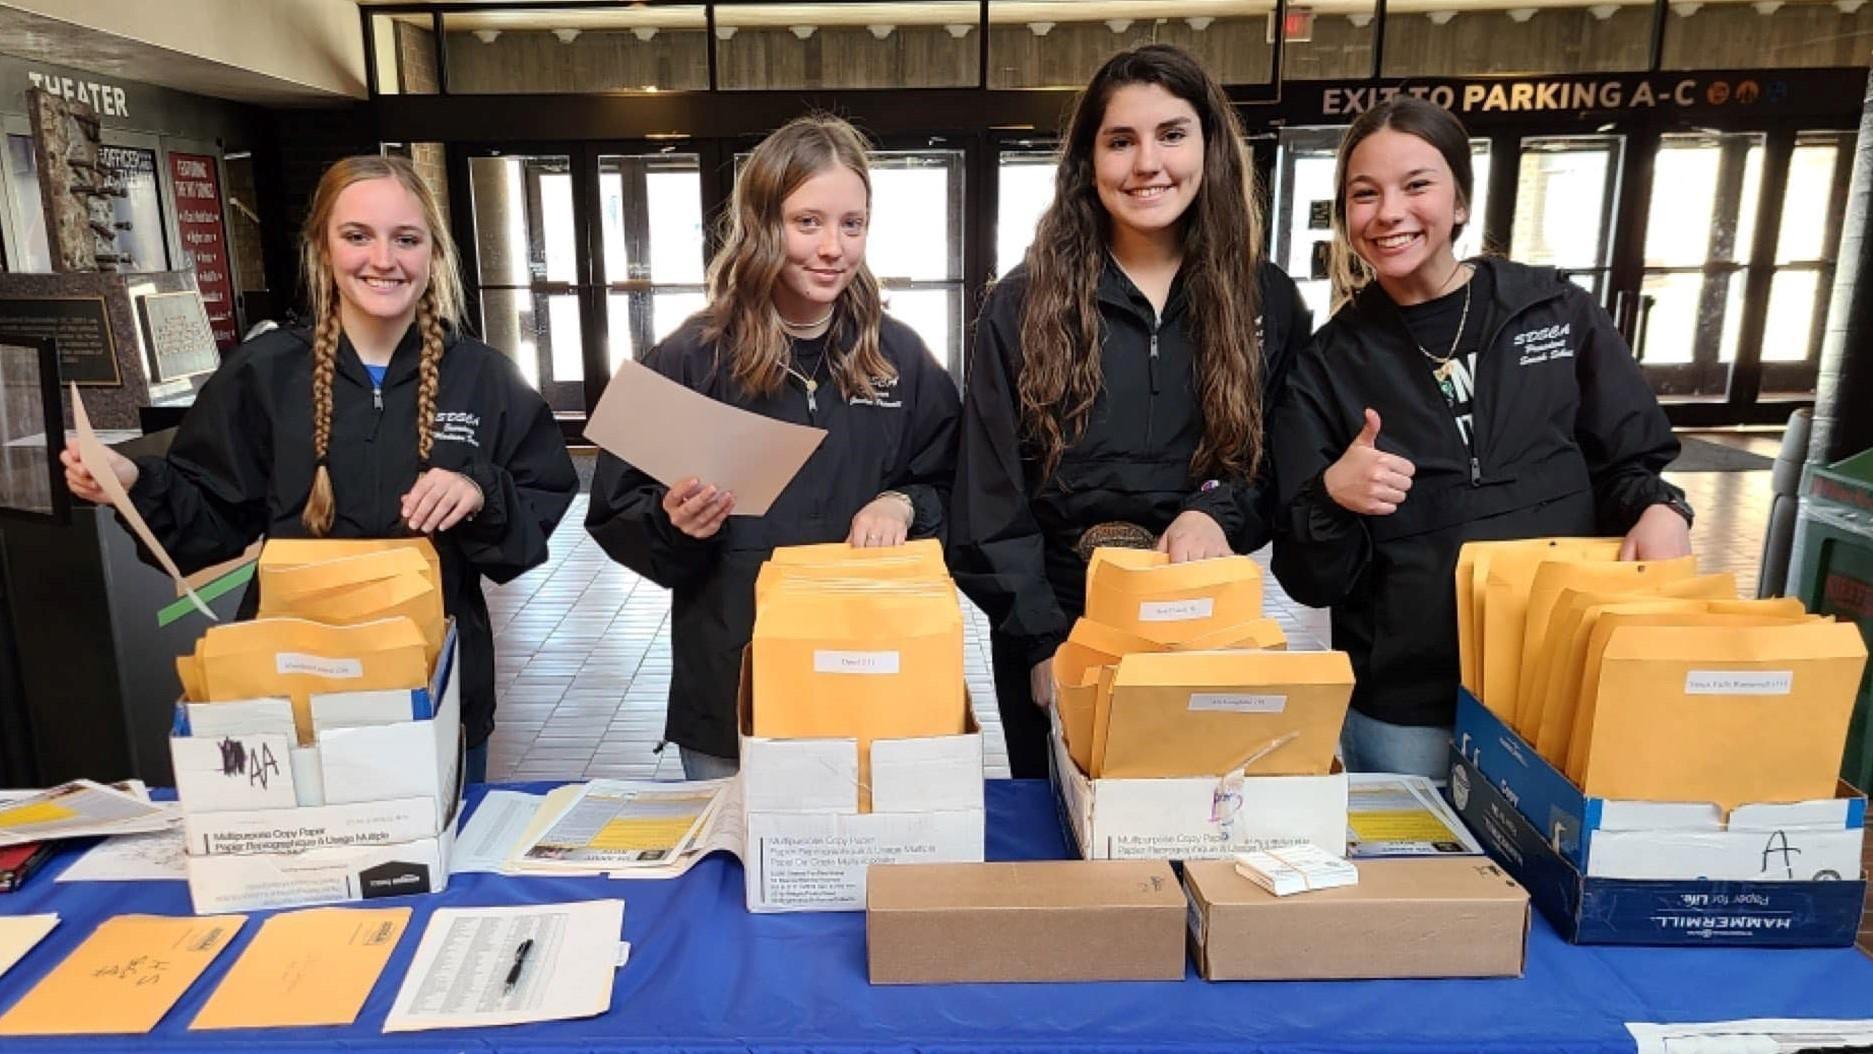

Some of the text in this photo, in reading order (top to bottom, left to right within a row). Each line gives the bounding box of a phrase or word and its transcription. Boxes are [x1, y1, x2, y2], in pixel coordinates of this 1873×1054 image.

[29, 71, 129, 117] THEATER
[1322, 87, 1400, 115] EXIT
[1463, 80, 1622, 112] PARKING
[1629, 80, 1696, 108] A-C
[272, 829, 298, 840] Copy
[299, 827, 326, 837] Paper
[1760, 829, 1802, 880] A
[1711, 894, 1729, 905] for
[1733, 892, 1770, 906] Paper
